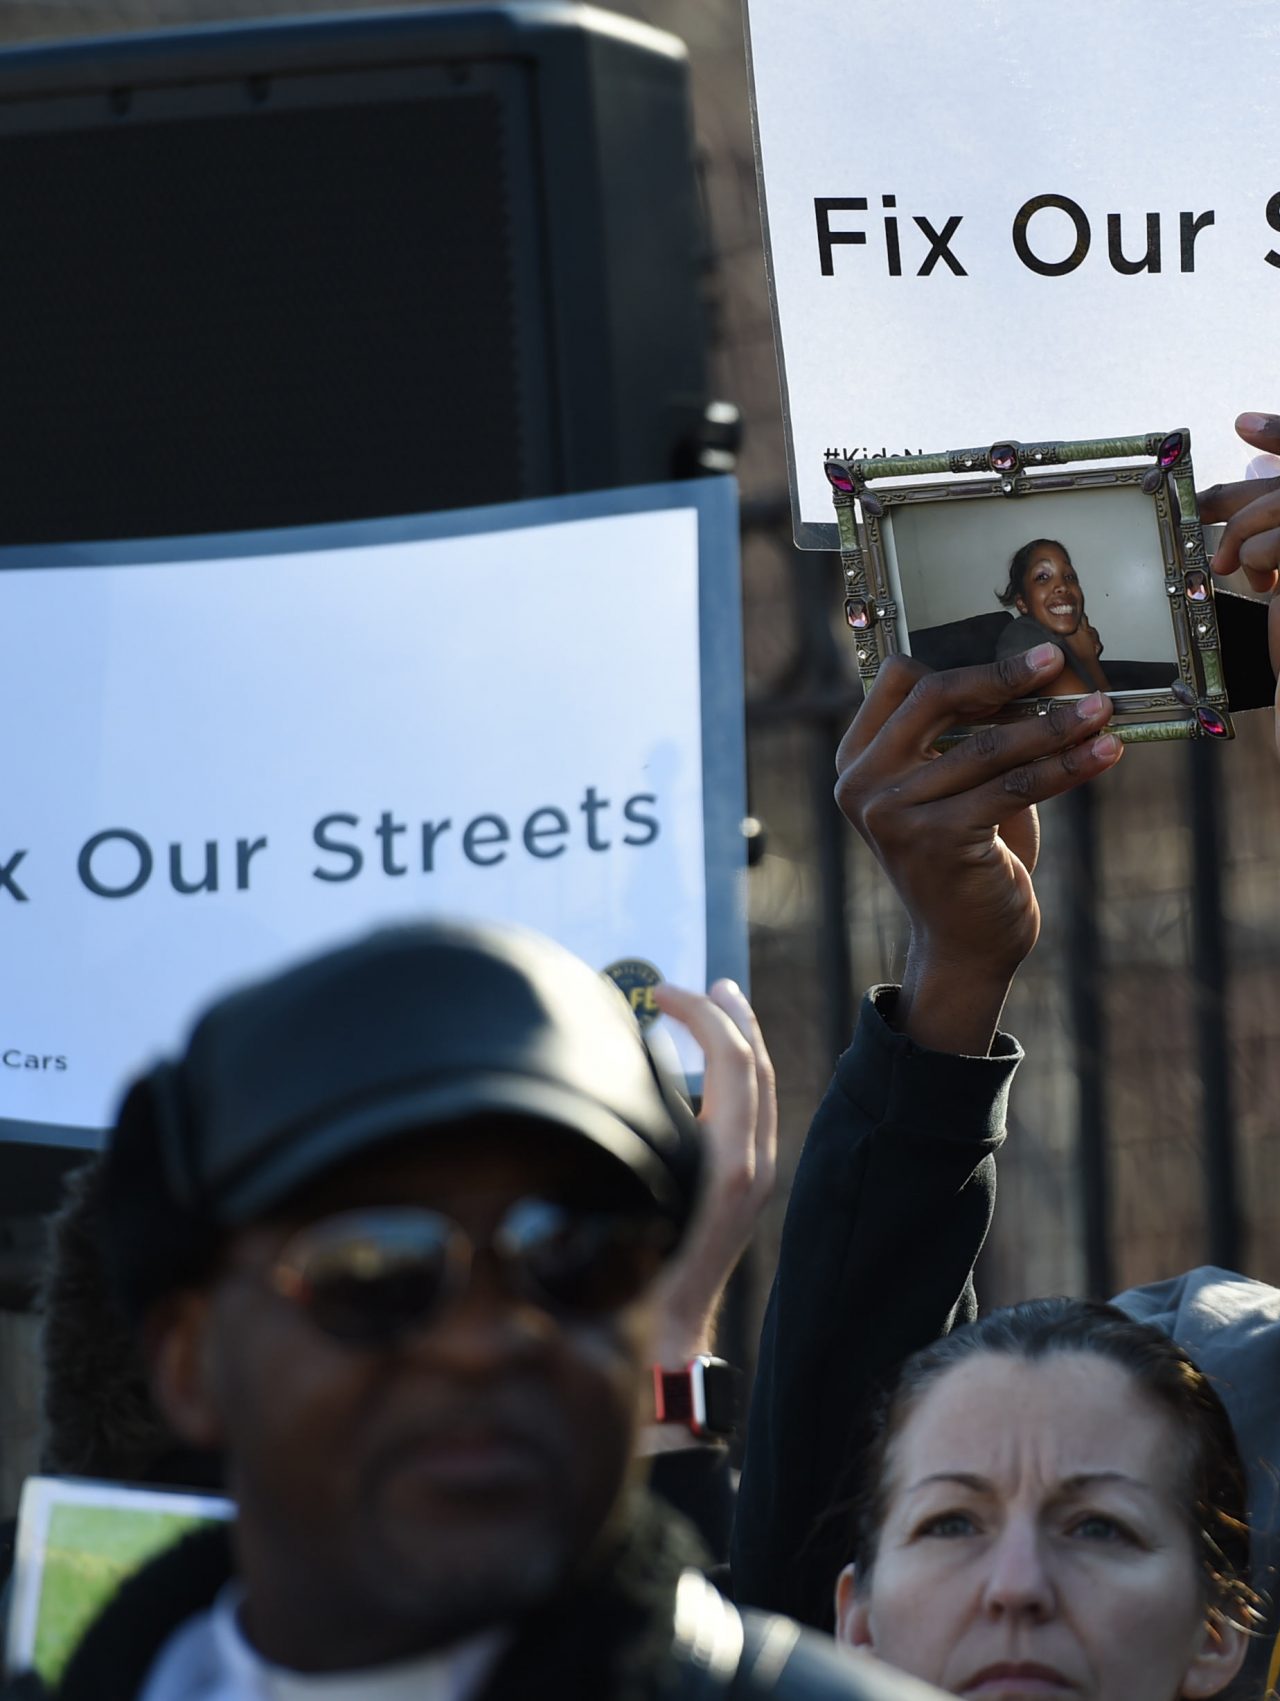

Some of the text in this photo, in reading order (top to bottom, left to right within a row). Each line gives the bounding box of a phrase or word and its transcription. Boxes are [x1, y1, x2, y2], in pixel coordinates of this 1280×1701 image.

[813, 194, 969, 277] Fix
[1012, 193, 1215, 277] Our
[76, 828, 267, 900] Our
[312, 785, 660, 883] Streets
[2, 1049, 68, 1071] Cars
